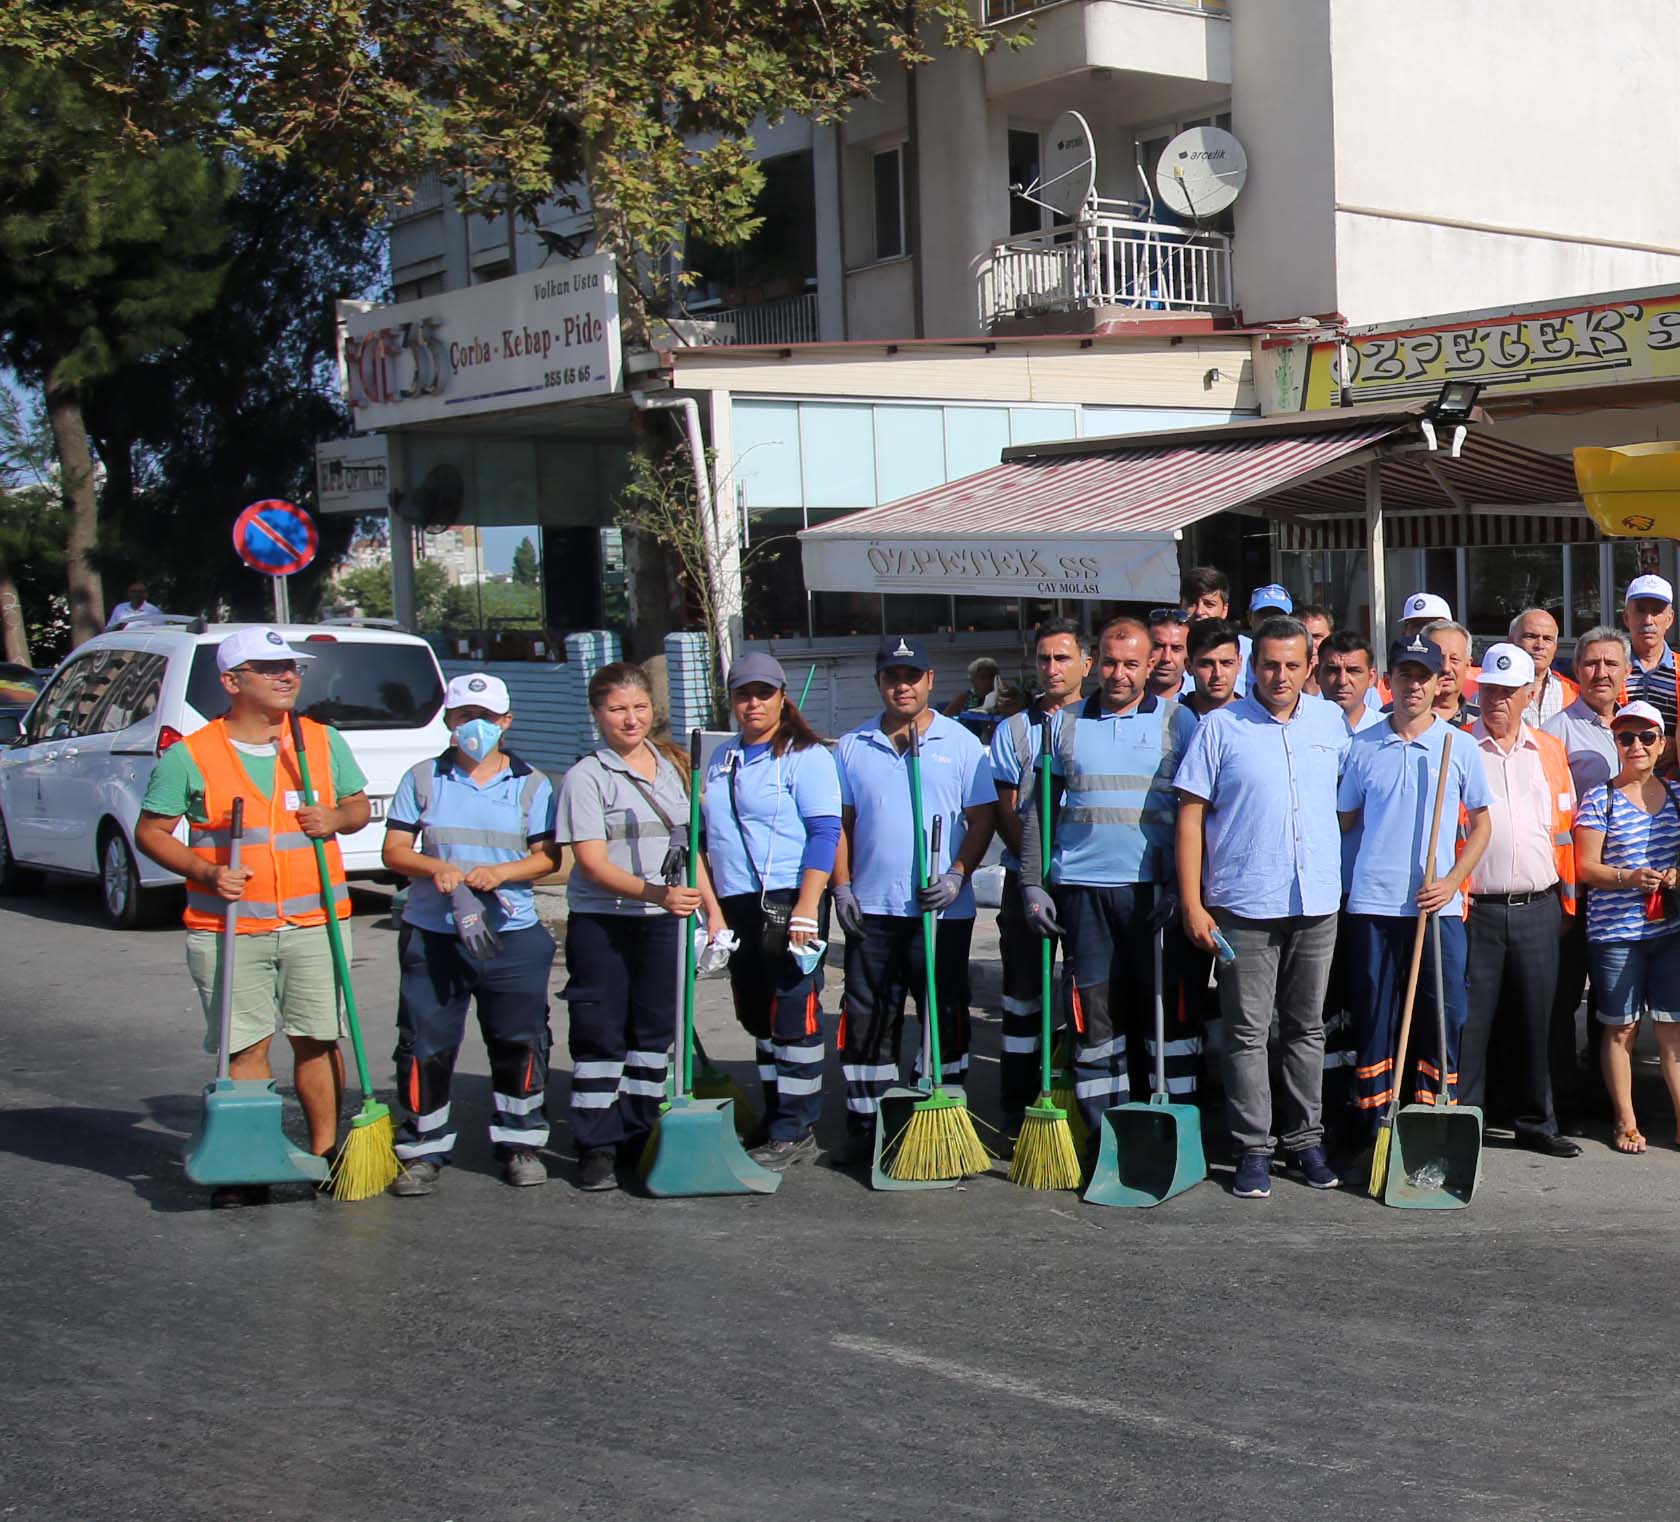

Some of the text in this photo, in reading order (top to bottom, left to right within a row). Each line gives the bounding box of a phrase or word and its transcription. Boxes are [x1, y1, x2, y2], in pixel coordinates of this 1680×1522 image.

[533, 272, 599, 301] Volkan Usta
[449, 336, 492, 375] Çorba
[502, 326, 552, 360] Kebap
[563, 311, 603, 347] Pide
[544, 370, 562, 389] 255
[578, 364, 591, 382] 65
[867, 540, 1047, 578] ÖZPETEK
[1059, 583, 1101, 595] MOLASI
